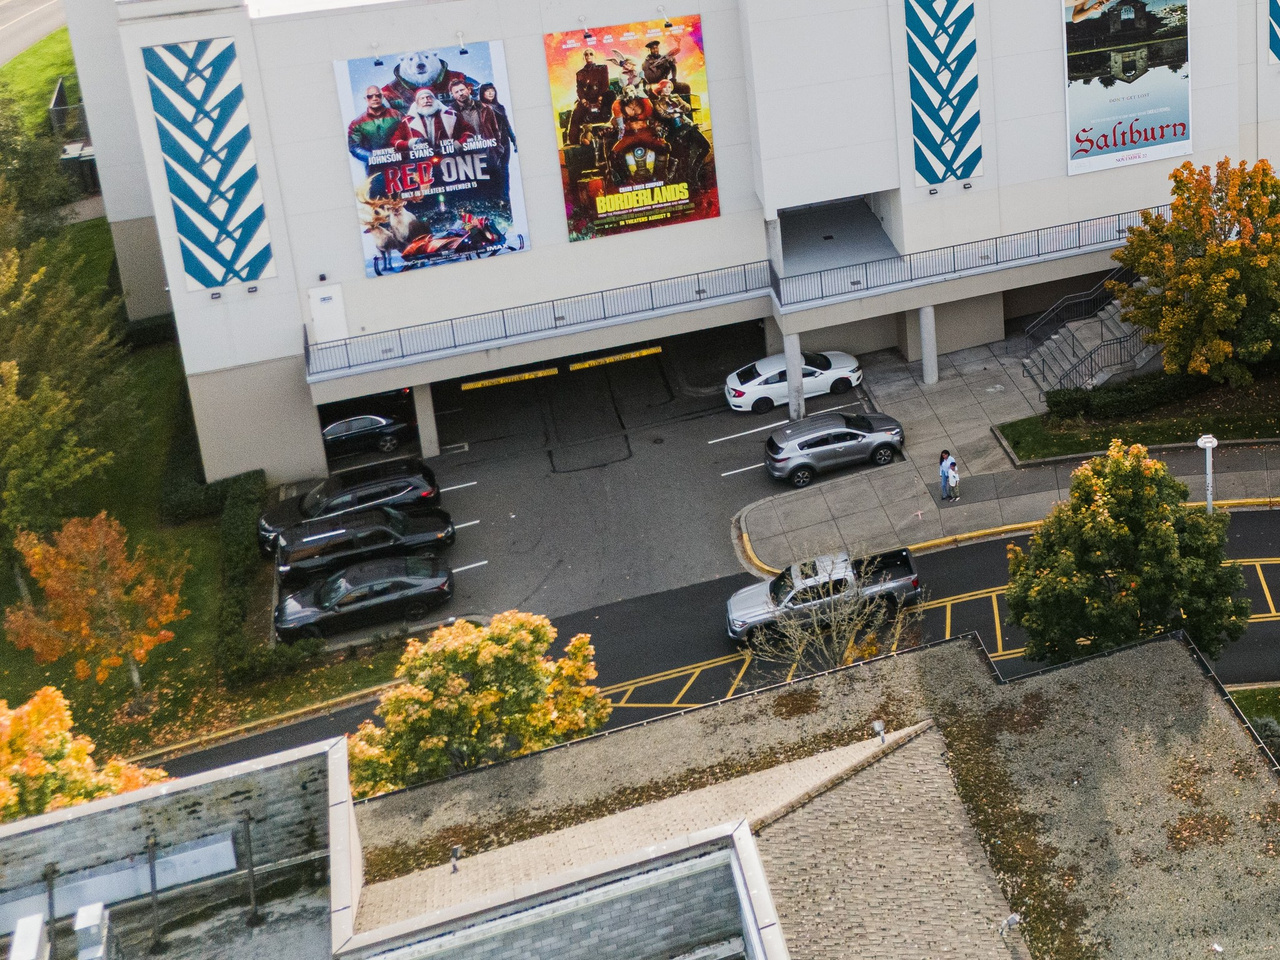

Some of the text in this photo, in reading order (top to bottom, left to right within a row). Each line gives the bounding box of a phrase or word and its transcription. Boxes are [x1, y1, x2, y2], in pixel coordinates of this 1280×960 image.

[462, 138, 497, 151] SIMMONS
[1071, 117, 1187, 159] Saltburn
[409, 148, 434, 159] EVANS
[441, 144, 455, 154] LIU
[368, 152, 402, 166] JOHNSON
[384, 154, 490, 195] RED ONE
[596, 182, 689, 214] BORDERLANDS
[486, 243, 508, 251] IMAX
